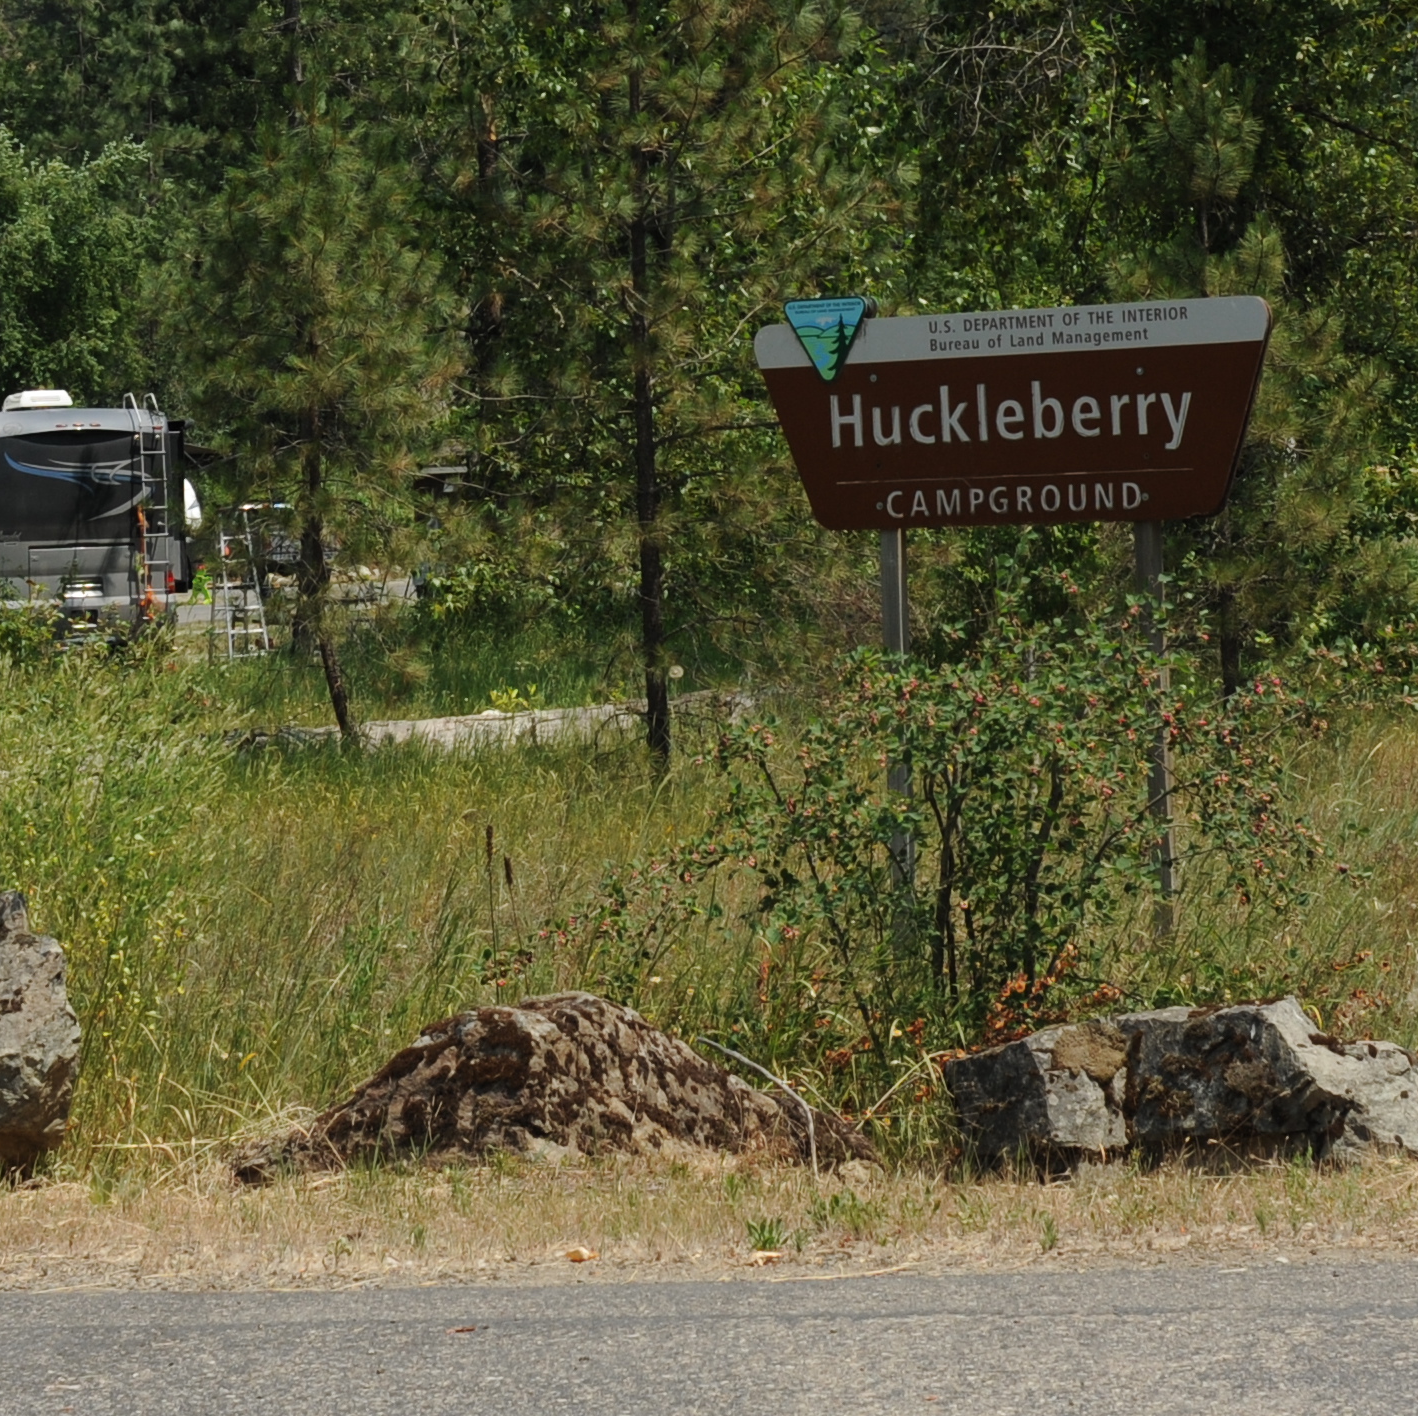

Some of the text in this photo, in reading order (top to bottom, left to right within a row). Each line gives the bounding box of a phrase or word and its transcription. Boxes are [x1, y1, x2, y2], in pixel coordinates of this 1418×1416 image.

[928, 306, 1189, 334] U.S. DEPARTMENT OF THE INTERIOR
[929, 327, 1149, 352] Bureau of Land Management
[829, 380, 1193, 450] Huckleberry
[885, 482, 1142, 519] CAMPGROUND
